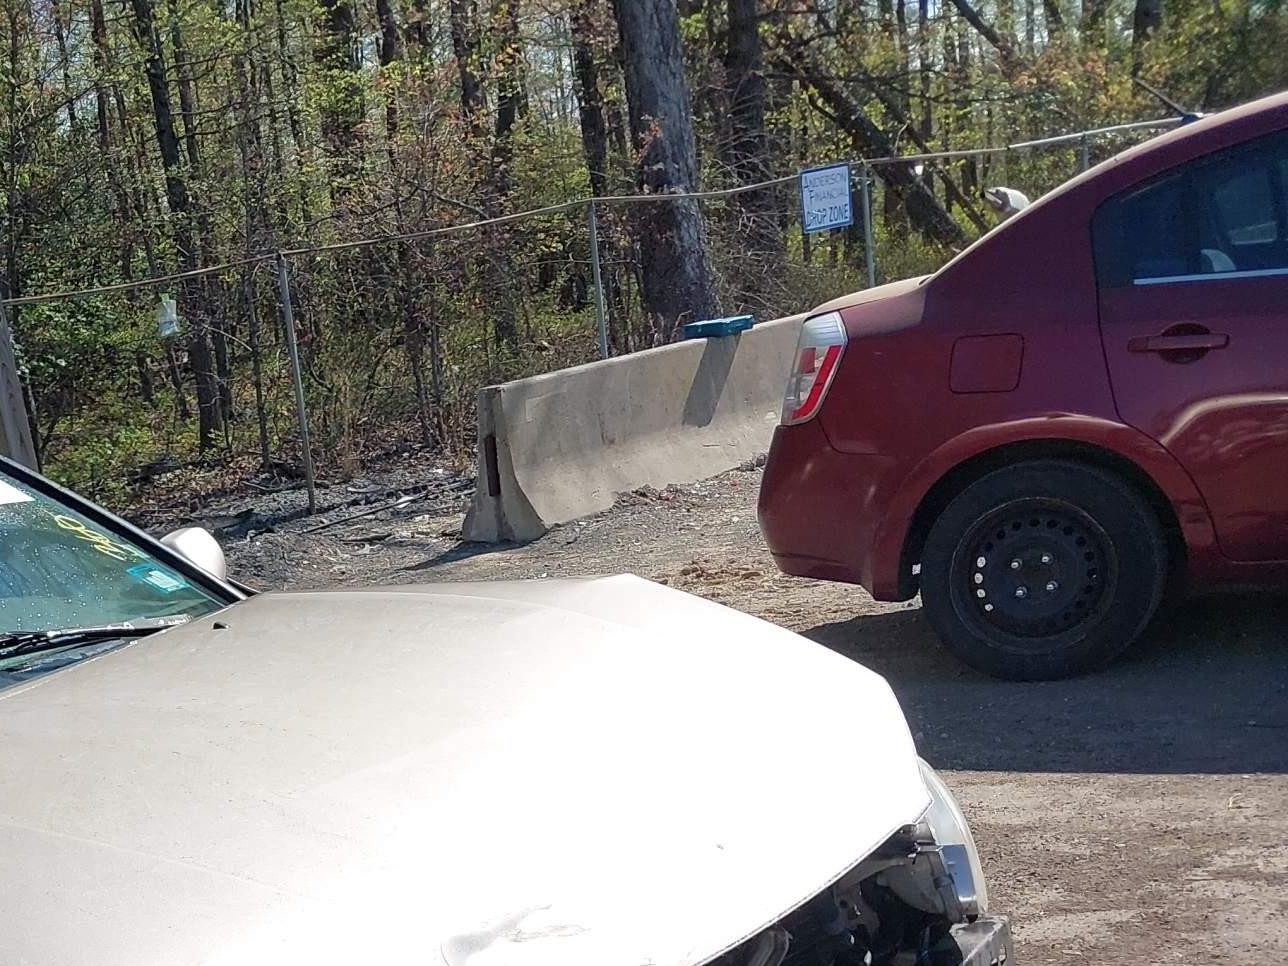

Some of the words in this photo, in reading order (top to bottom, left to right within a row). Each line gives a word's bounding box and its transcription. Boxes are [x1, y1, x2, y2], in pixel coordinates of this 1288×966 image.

[803, 172, 847, 189] ANDERSON
[807, 208, 827, 227] DROP
[828, 203, 849, 223] ZONE
